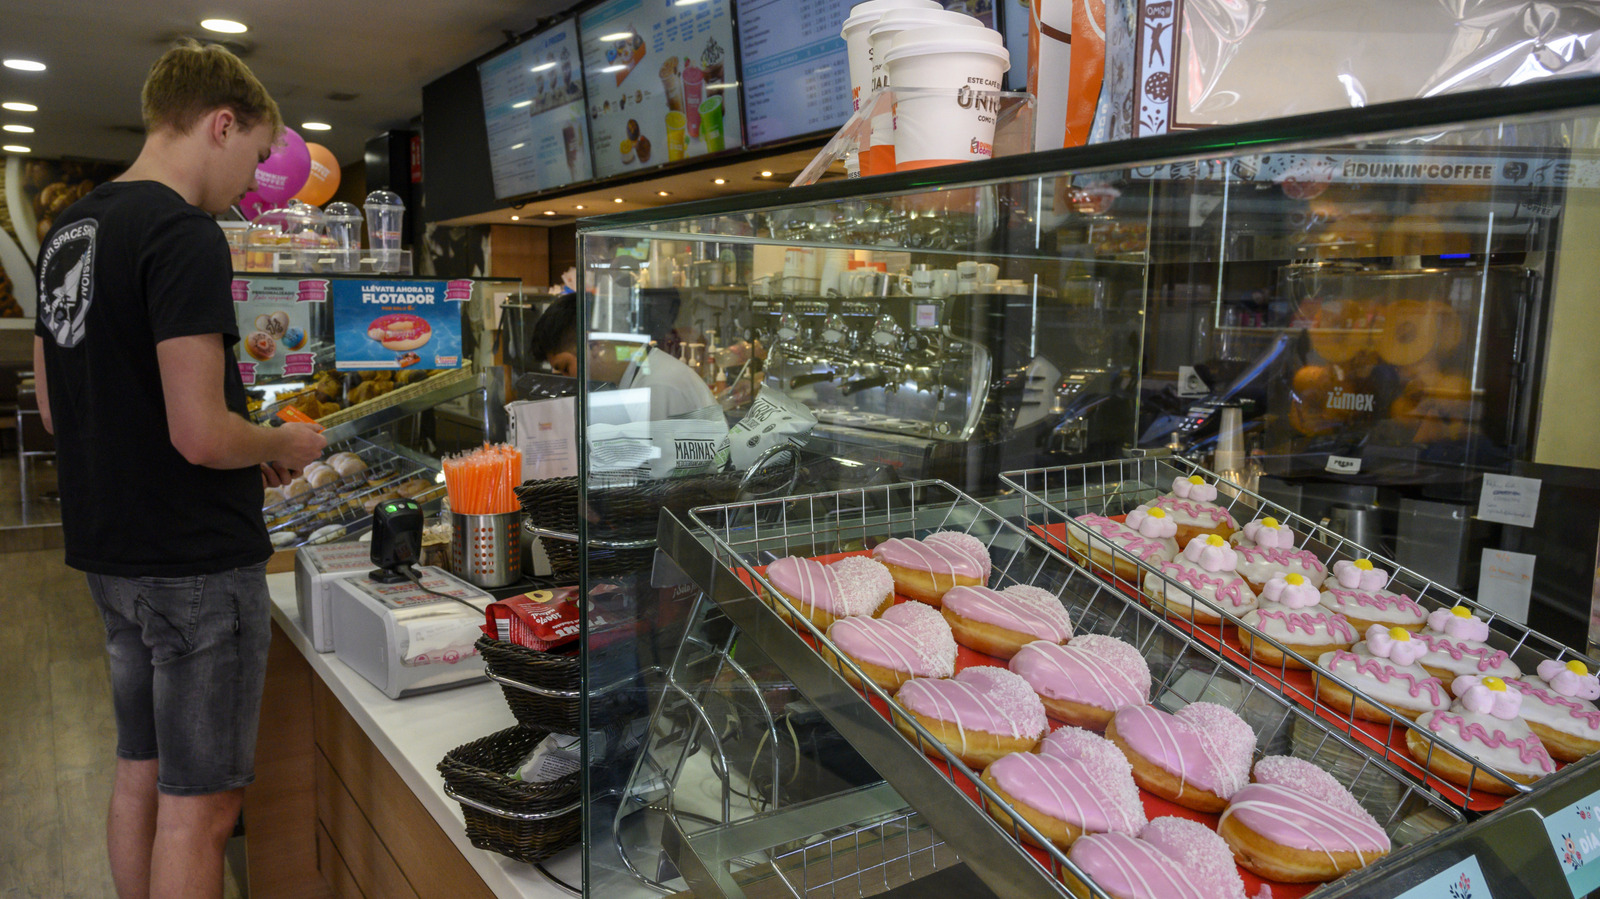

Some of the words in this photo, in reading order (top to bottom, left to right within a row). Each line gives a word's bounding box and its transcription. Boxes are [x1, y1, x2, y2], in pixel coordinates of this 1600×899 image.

[967, 77, 984, 85] ESTE
[361, 284, 395, 293] LLÉVATE
[362, 293, 435, 305] FLOTADOR
[675, 441, 716, 460] MARINAS
